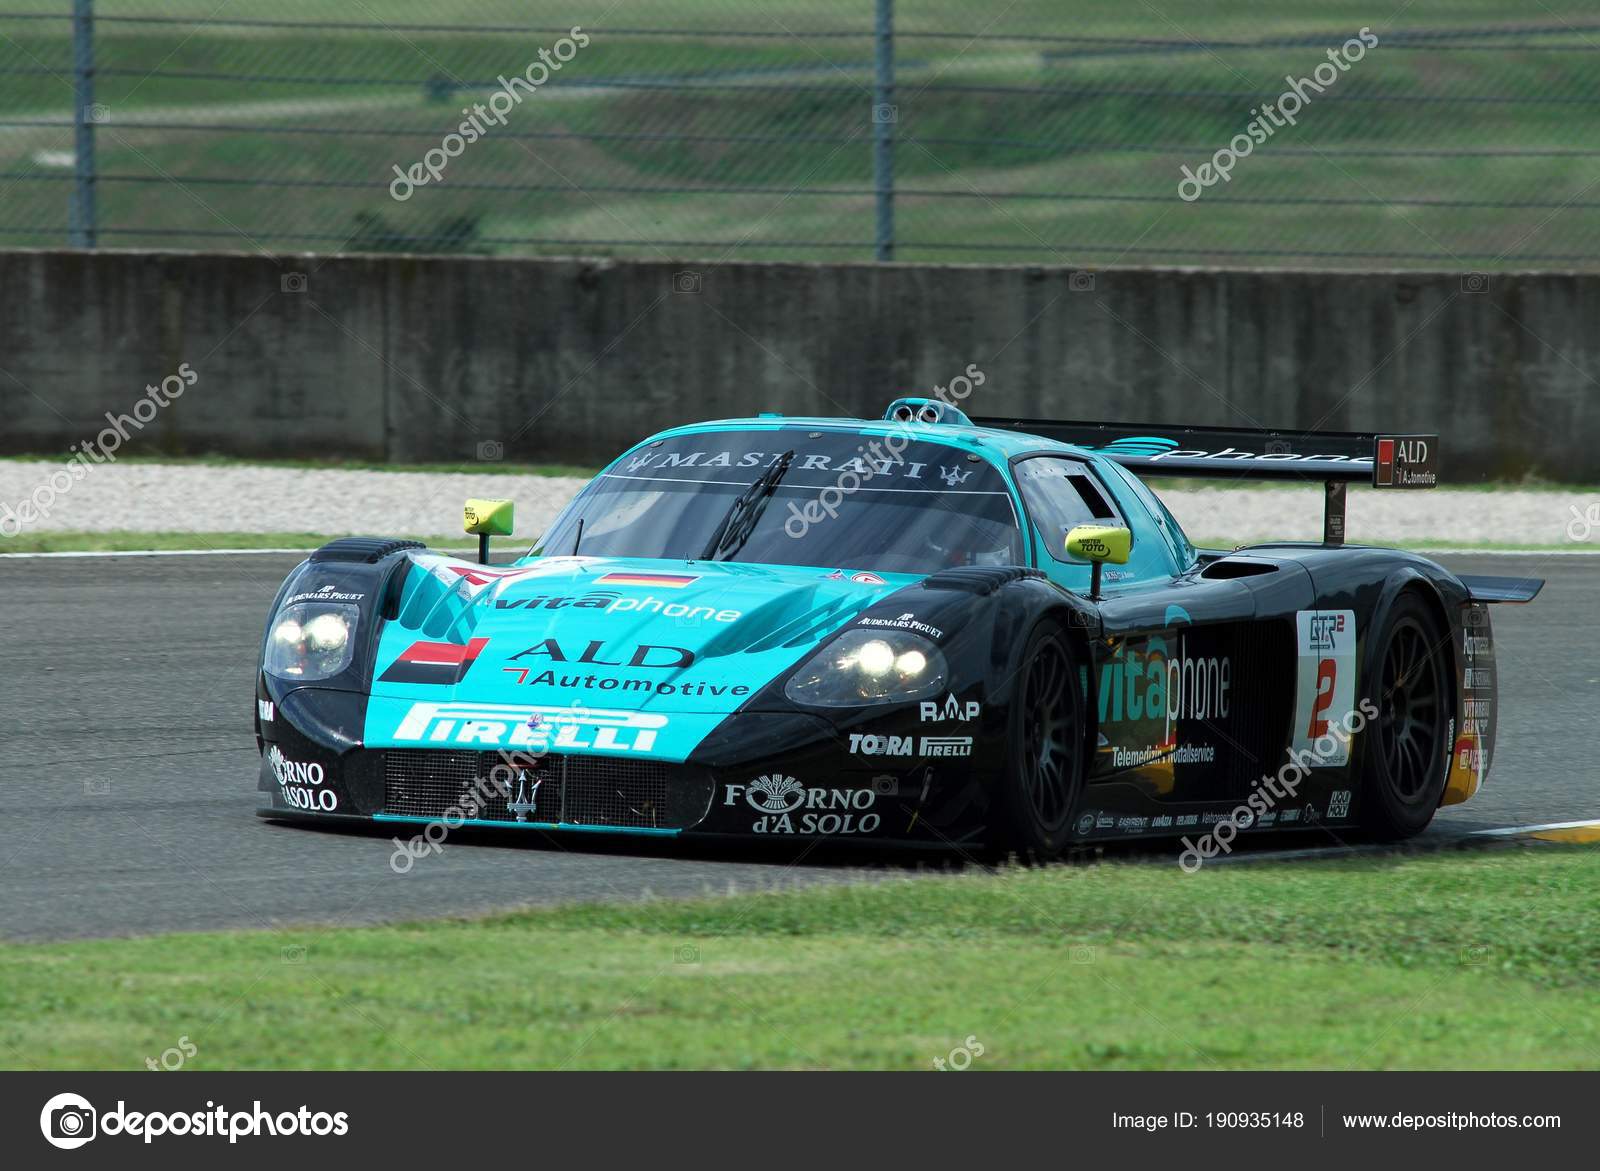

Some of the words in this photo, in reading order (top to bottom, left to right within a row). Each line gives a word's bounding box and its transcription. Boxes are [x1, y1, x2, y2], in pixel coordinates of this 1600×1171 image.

[1397, 440, 1428, 463] ALD
[1081, 543, 1105, 552] TOTO
[494, 595, 742, 623] vitaphone
[857, 617, 911, 628] AUDEMARS
[908, 620, 944, 638] PIGUET
[504, 638, 695, 668] ALD
[528, 669, 750, 697] Automotive
[1307, 658, 1337, 739] 2
[393, 702, 669, 751] PIRELLI
[918, 736, 973, 757] PIRELLI
[273, 760, 324, 785] ORNO
[723, 783, 876, 815] FORNO
